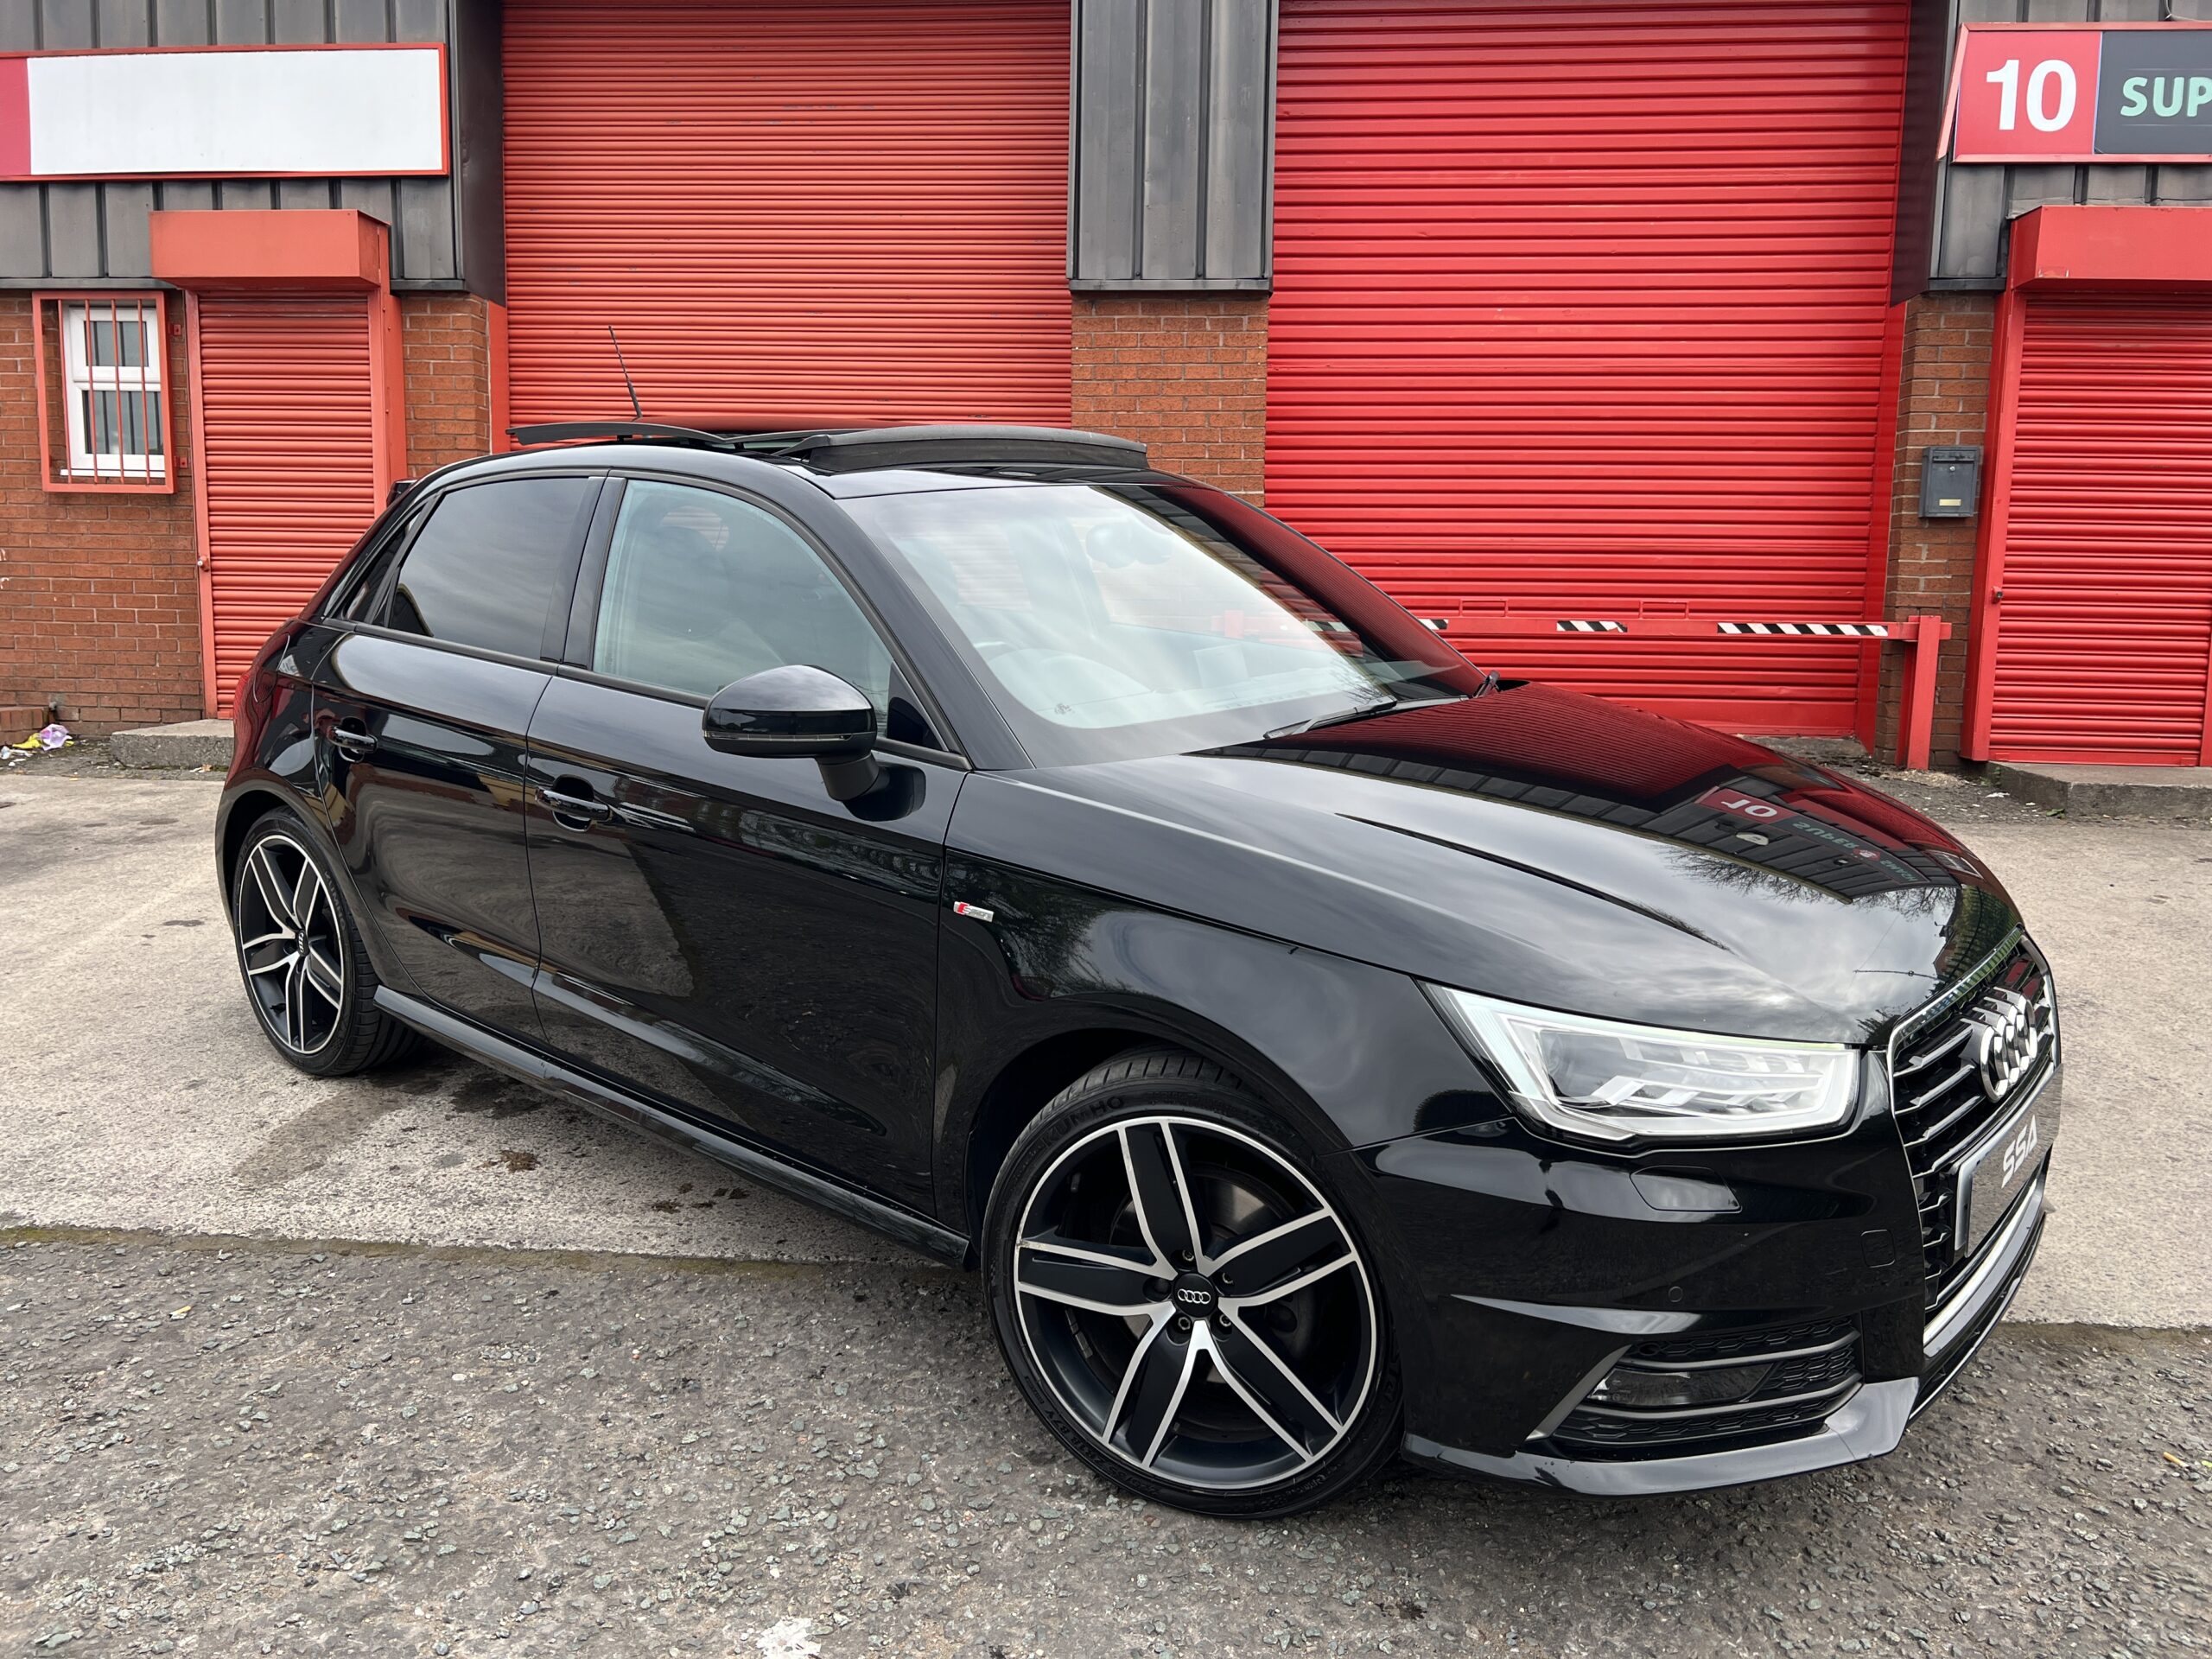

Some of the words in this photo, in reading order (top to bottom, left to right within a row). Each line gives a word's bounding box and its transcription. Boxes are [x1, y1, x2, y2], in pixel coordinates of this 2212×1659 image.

[1986, 59, 2076, 132] 10
[2120, 77, 2212, 118] SUP
[1043, 1096, 1123, 1147] KUMHO
[2002, 1116, 2037, 1189] SSA
